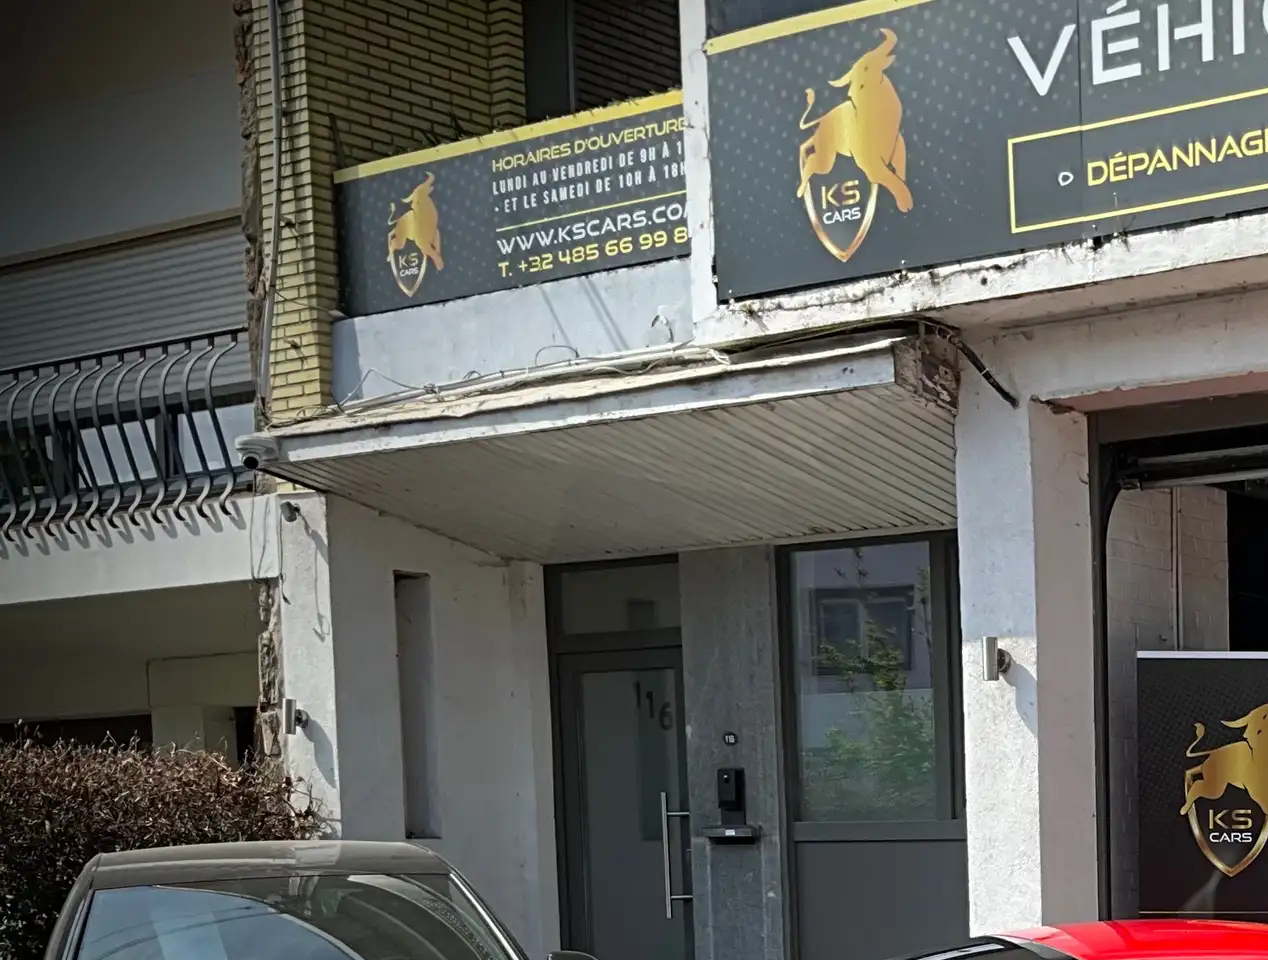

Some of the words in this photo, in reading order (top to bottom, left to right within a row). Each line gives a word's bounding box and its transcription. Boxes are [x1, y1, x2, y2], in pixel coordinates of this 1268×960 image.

[492, 142, 571, 173] HORAIRES
[493, 176, 527, 196] LUNDI
[533, 170, 547, 187] AU
[552, 153, 613, 182] VENDREDI
[619, 150, 634, 167] DE
[640, 146, 656, 163] 9H
[662, 141, 670, 158] À
[504, 197, 517, 213] ET
[524, 193, 537, 209] LE
[543, 181, 590, 205] SAMEDI
[596, 176, 611, 193] DE
[619, 170, 642, 188] 10H
[648, 165, 656, 182] À
[821, 179, 861, 209] KS
[497, 203, 687, 254] WWW.KSCARS.CO
[822, 206, 861, 225] CARS
[399, 252, 419, 269] KS
[498, 261, 512, 278] T.
[558, 243, 600, 264] 485
[605, 237, 633, 257] 66
[639, 230, 667, 250] 99
[400, 267, 420, 277] CARS
[1209, 809, 1252, 830] KS
[1209, 832, 1252, 843] CARS
